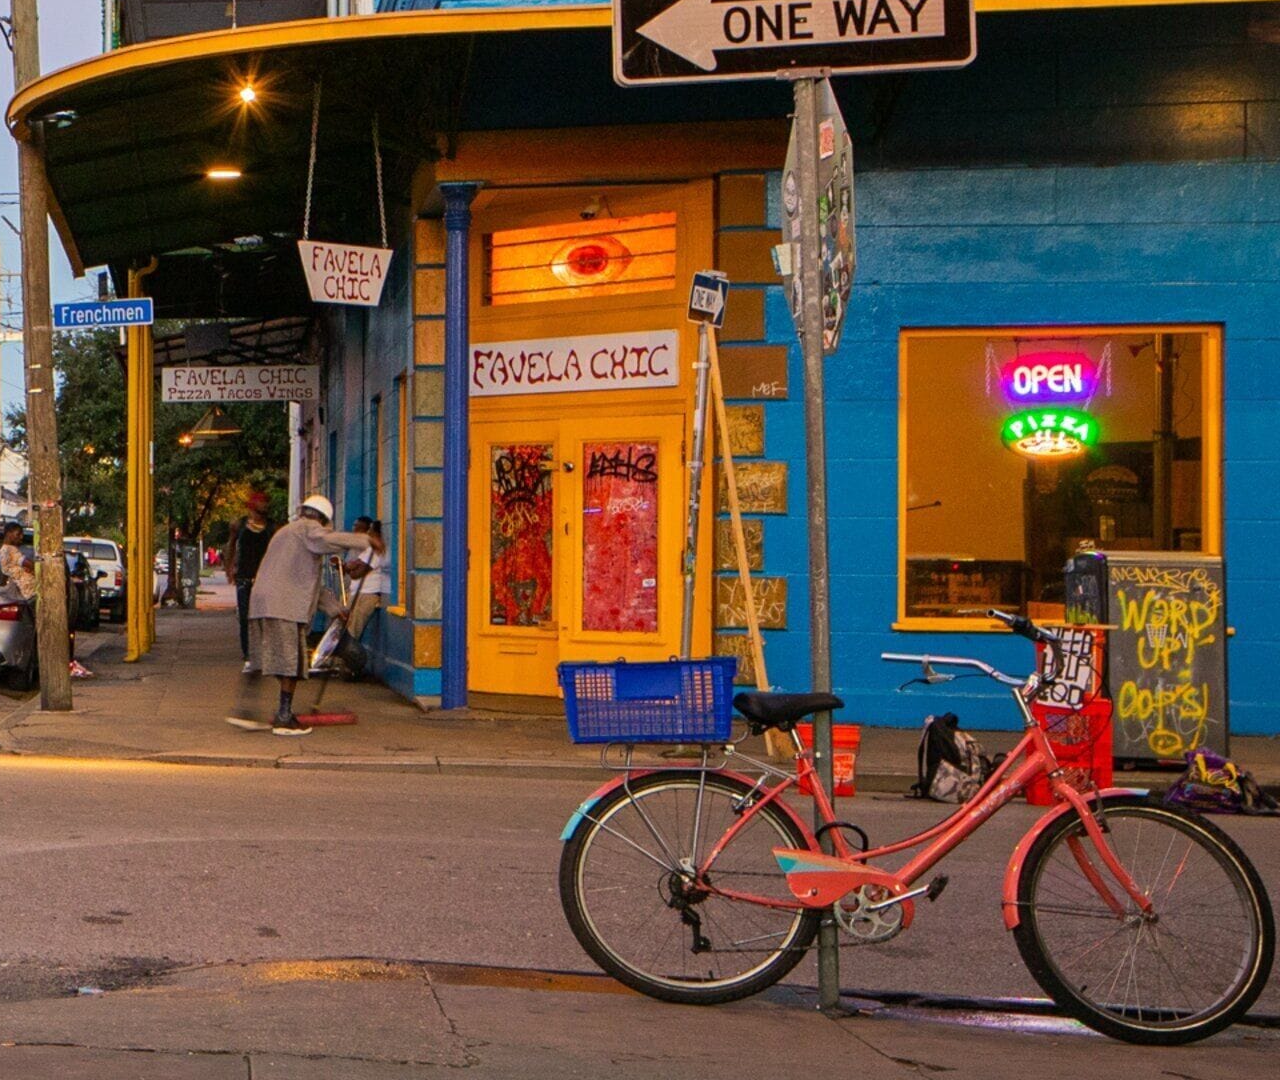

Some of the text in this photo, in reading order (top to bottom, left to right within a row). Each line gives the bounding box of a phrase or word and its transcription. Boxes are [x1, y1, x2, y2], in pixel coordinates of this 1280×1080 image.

[723, 2, 814, 44] ONE
[312, 245, 382, 279] FAVELA
[323, 275, 371, 301] CHIC
[693, 288, 706, 308] ONE
[61, 304, 144, 324] Frenchmen
[174, 367, 307, 386] FAVELA CHIC
[473, 343, 669, 389] FAVELA CHIC
[1013, 363, 1082, 395] OPEN
[167, 387, 314, 400] PIZZA TACOS WINGS
[1009, 414, 1089, 441] PIZZA
[1117, 589, 1219, 639] WORD
